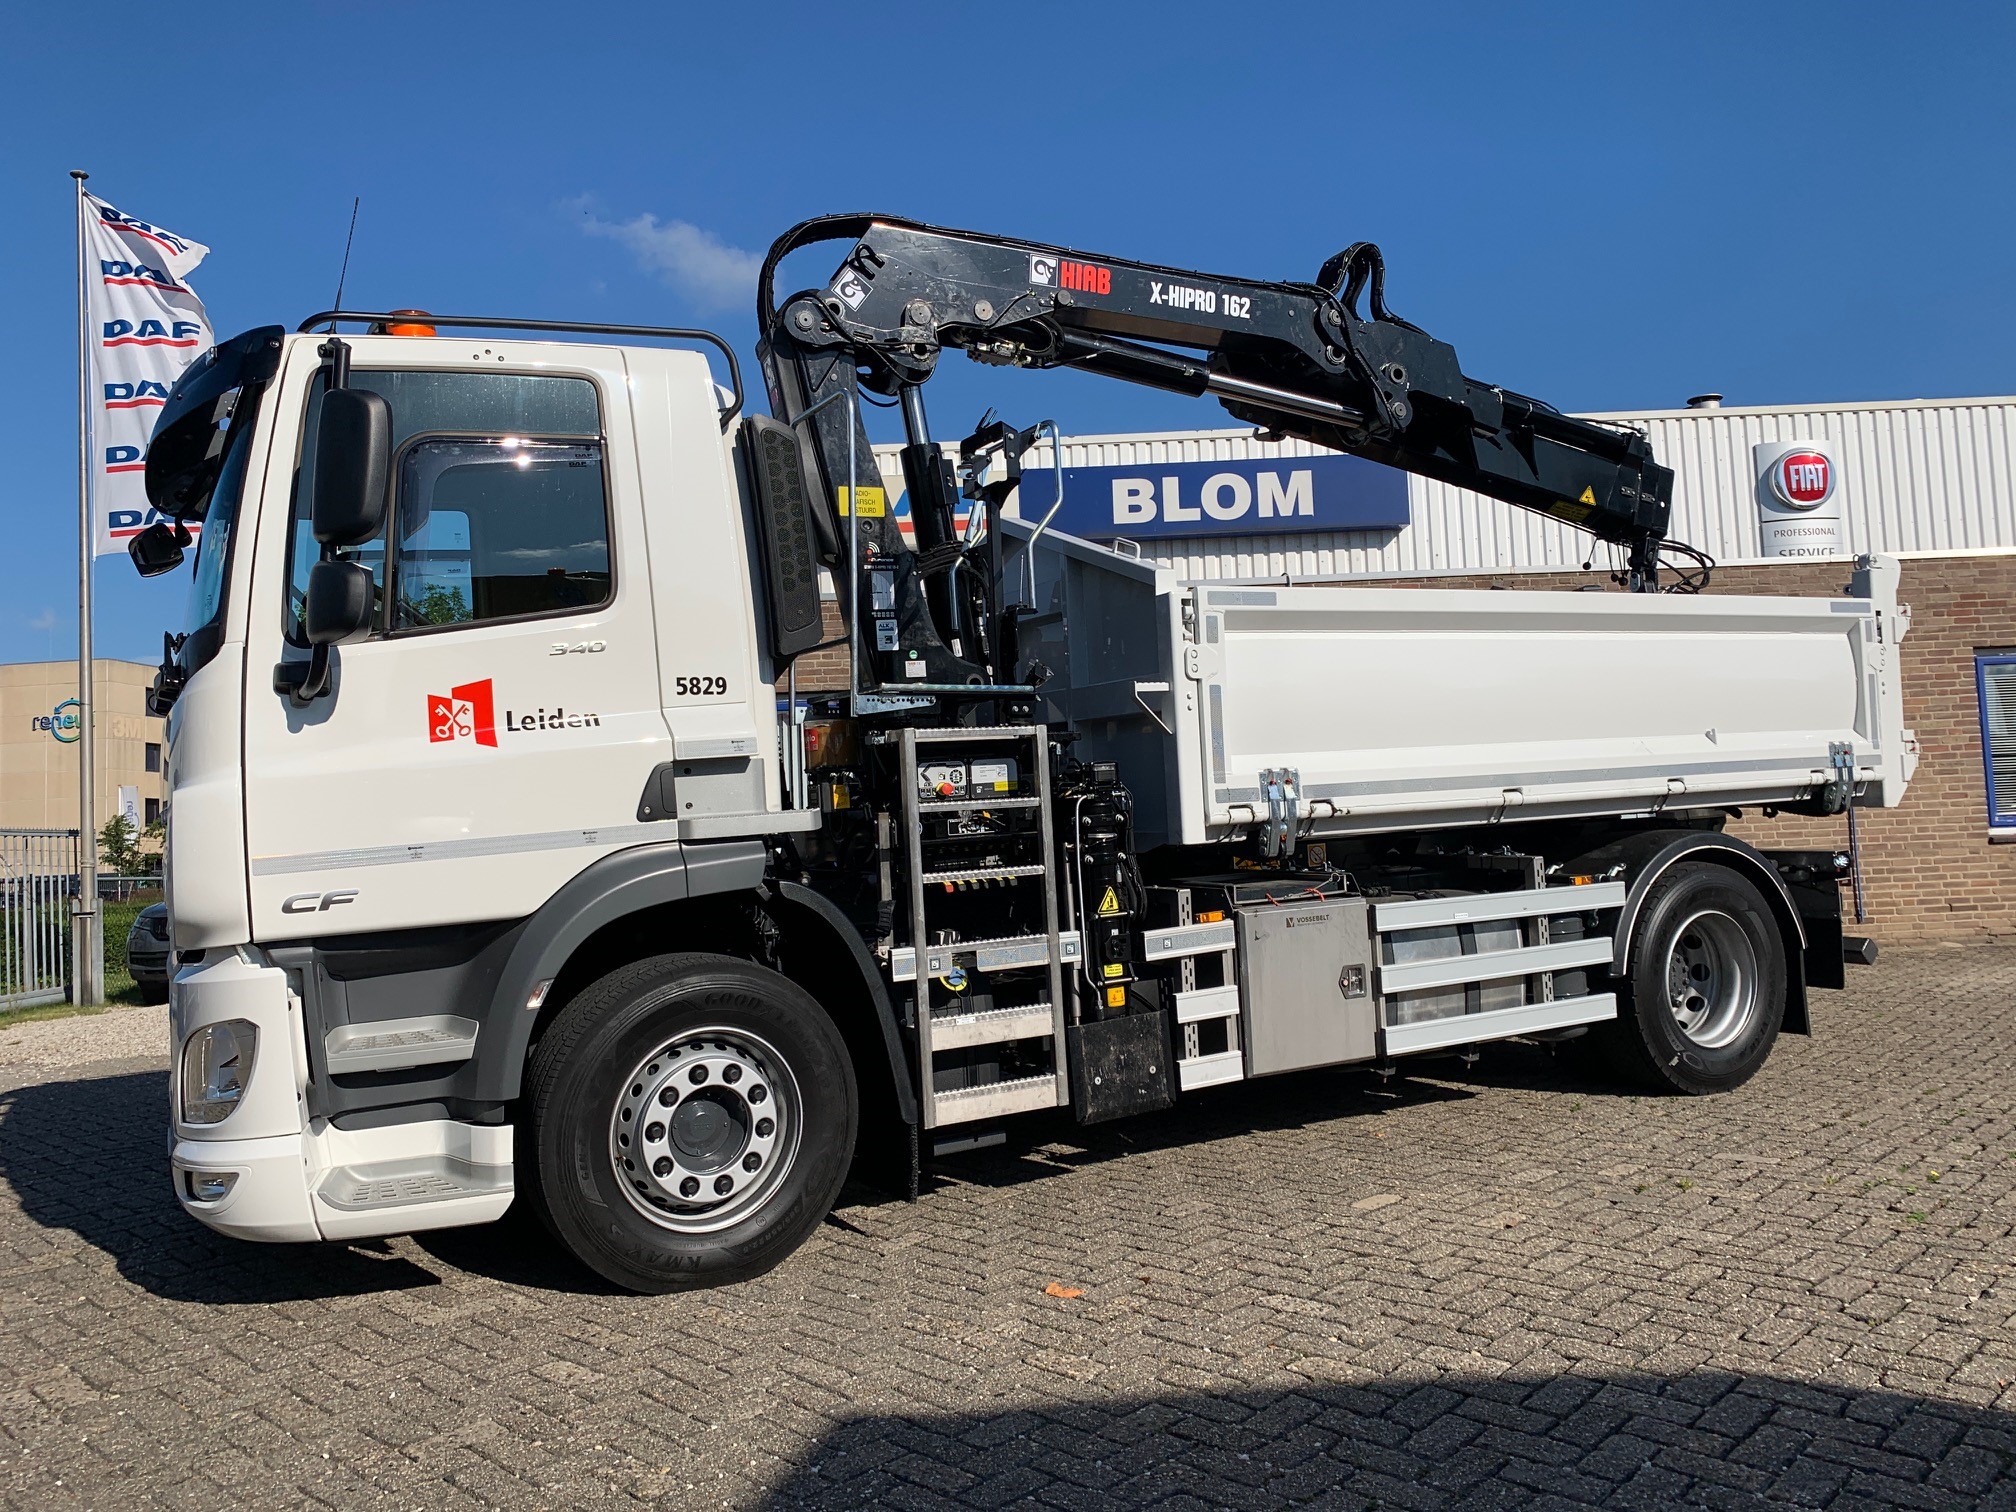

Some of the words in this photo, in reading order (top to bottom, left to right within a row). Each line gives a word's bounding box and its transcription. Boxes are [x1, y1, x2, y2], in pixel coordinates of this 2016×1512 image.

[1060, 261, 1112, 295] HIAB
[1150, 281, 1216, 314] X-HIPRO
[1222, 294, 1251, 319] 162
[103, 319, 200, 339] DAF
[104, 380, 178, 400] DA
[1789, 463, 1825, 491] FIAT
[1112, 469, 1314, 524] BLOM
[1774, 527, 1835, 538] PROFESSIONAL
[549, 640, 607, 656] 340
[675, 676, 727, 695] 5829
[506, 708, 601, 732] Leiden
[281, 888, 360, 914] CF
[1296, 914, 1330, 923] VOSSEBELT
